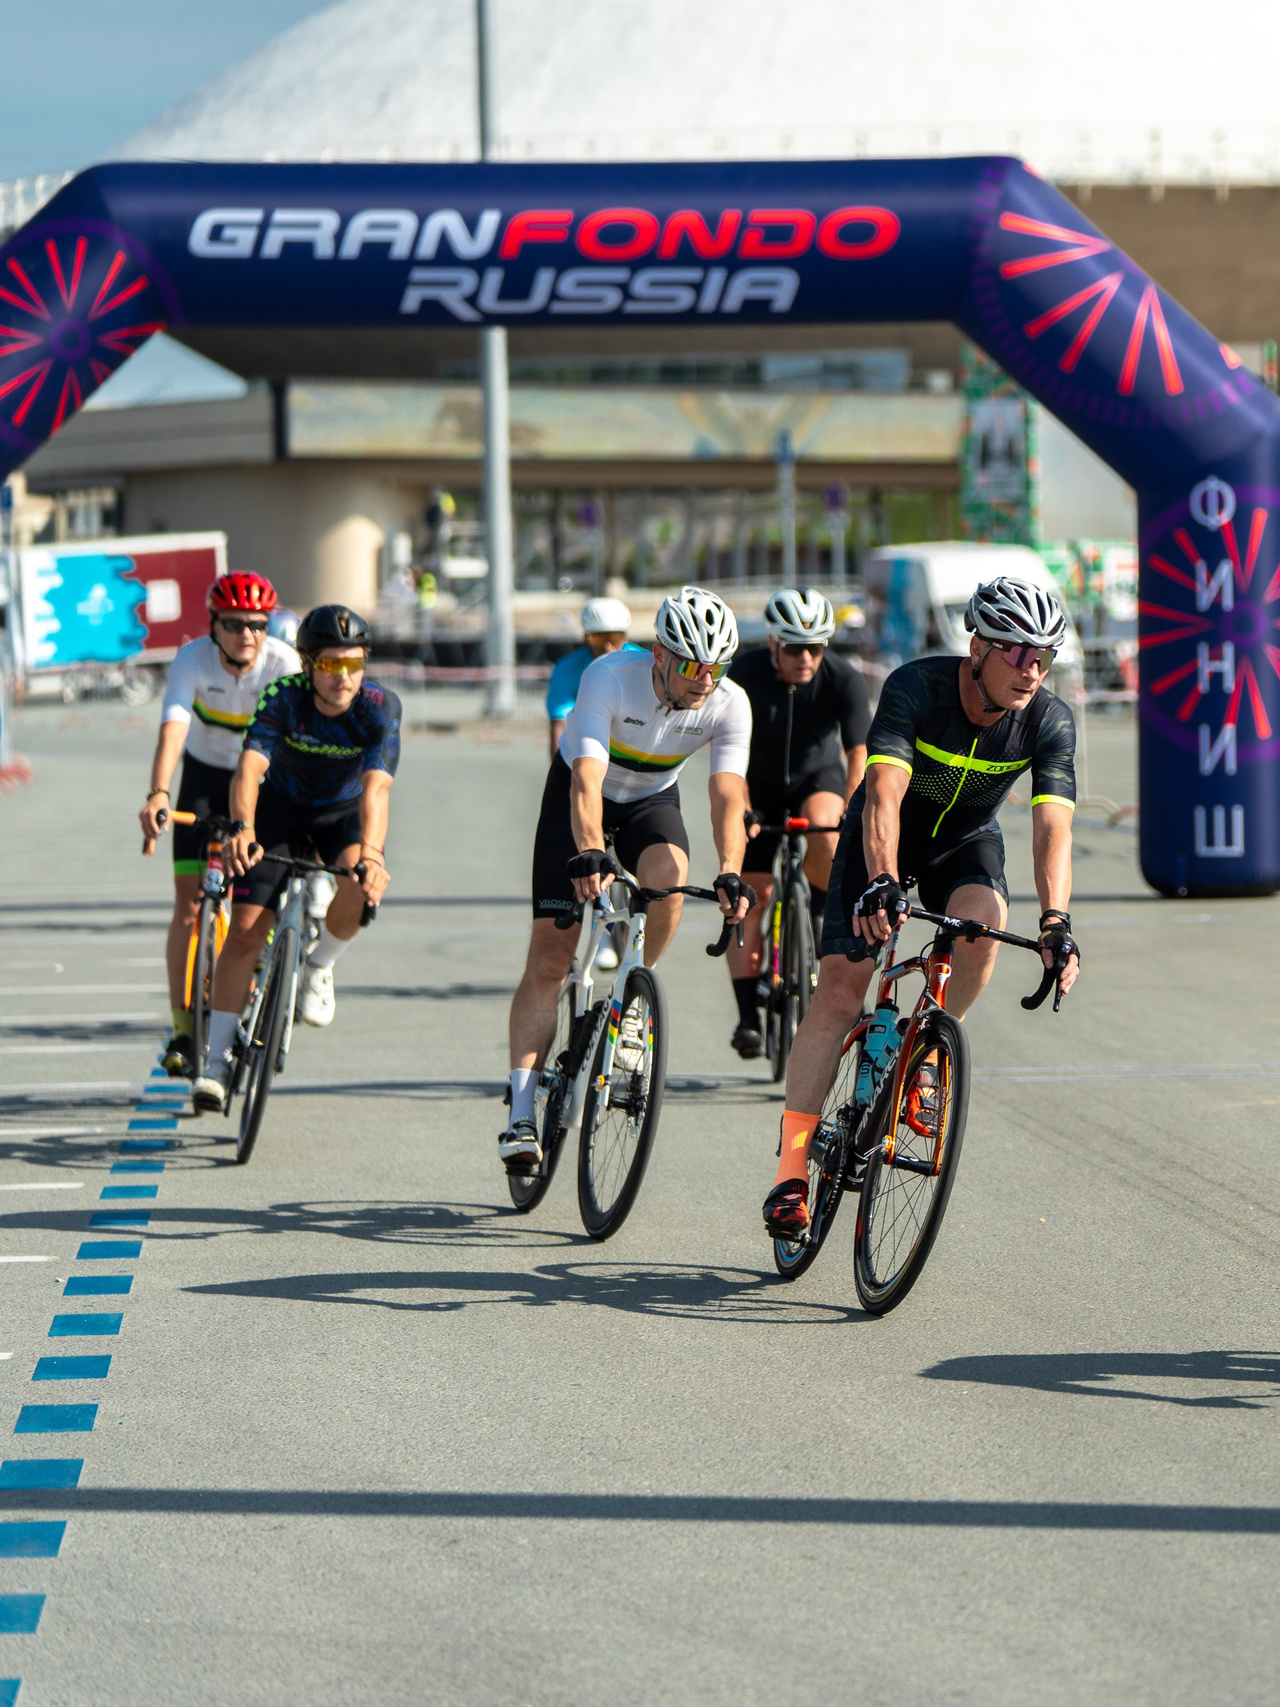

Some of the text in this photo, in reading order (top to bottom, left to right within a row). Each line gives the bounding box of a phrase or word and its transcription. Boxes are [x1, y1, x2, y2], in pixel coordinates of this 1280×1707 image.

[399, 266, 800, 322] RUSSIA
[1188, 475, 1246, 858] ФИНИШ
[539, 899, 573, 909] VELOSPO
